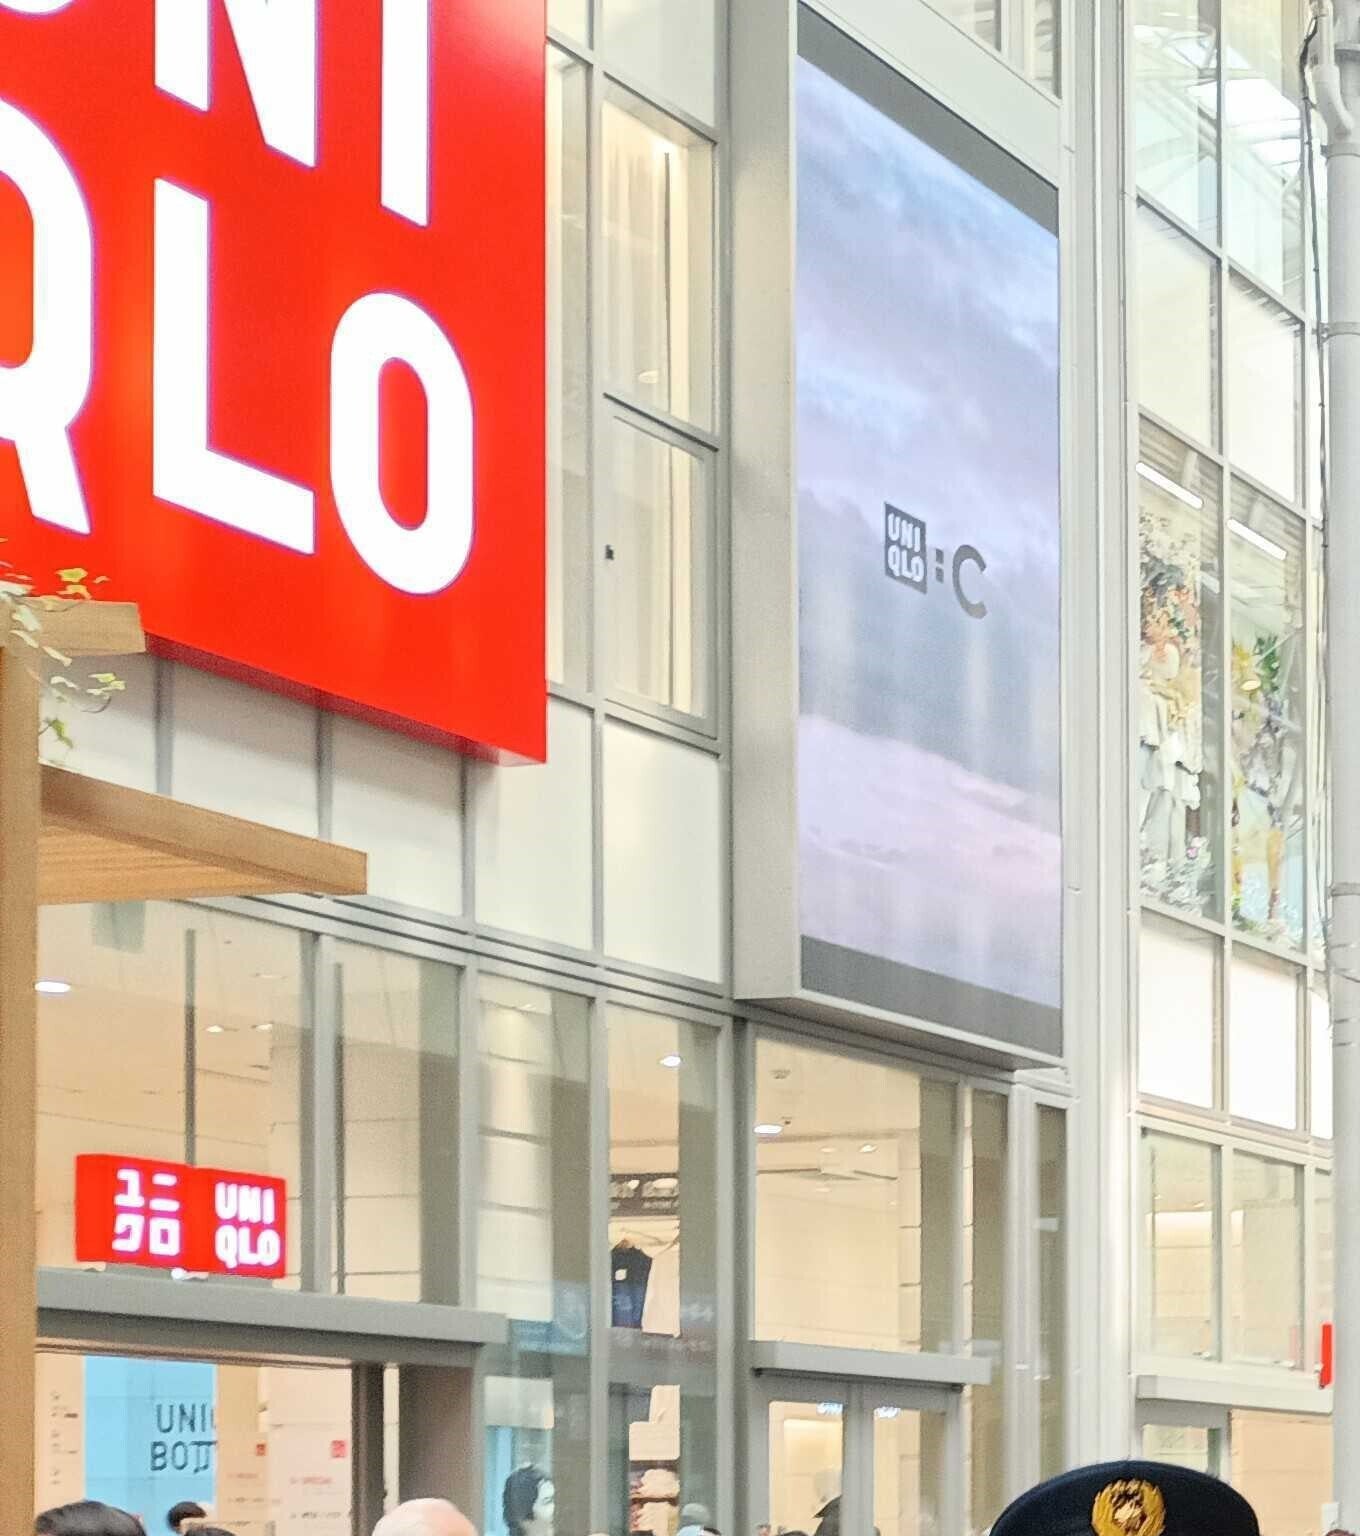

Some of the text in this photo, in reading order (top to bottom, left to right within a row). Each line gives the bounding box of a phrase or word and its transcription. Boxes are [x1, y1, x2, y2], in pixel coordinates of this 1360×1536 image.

[887, 512, 921, 553] UNI
[887, 544, 925, 583] QLO
[113, 1168, 181, 1212] ユニ
[214, 1181, 276, 1225] UNI
[111, 1213, 181, 1256] クロ
[214, 1224, 281, 1269] QLO
[156, 1402, 216, 1433] UNI
